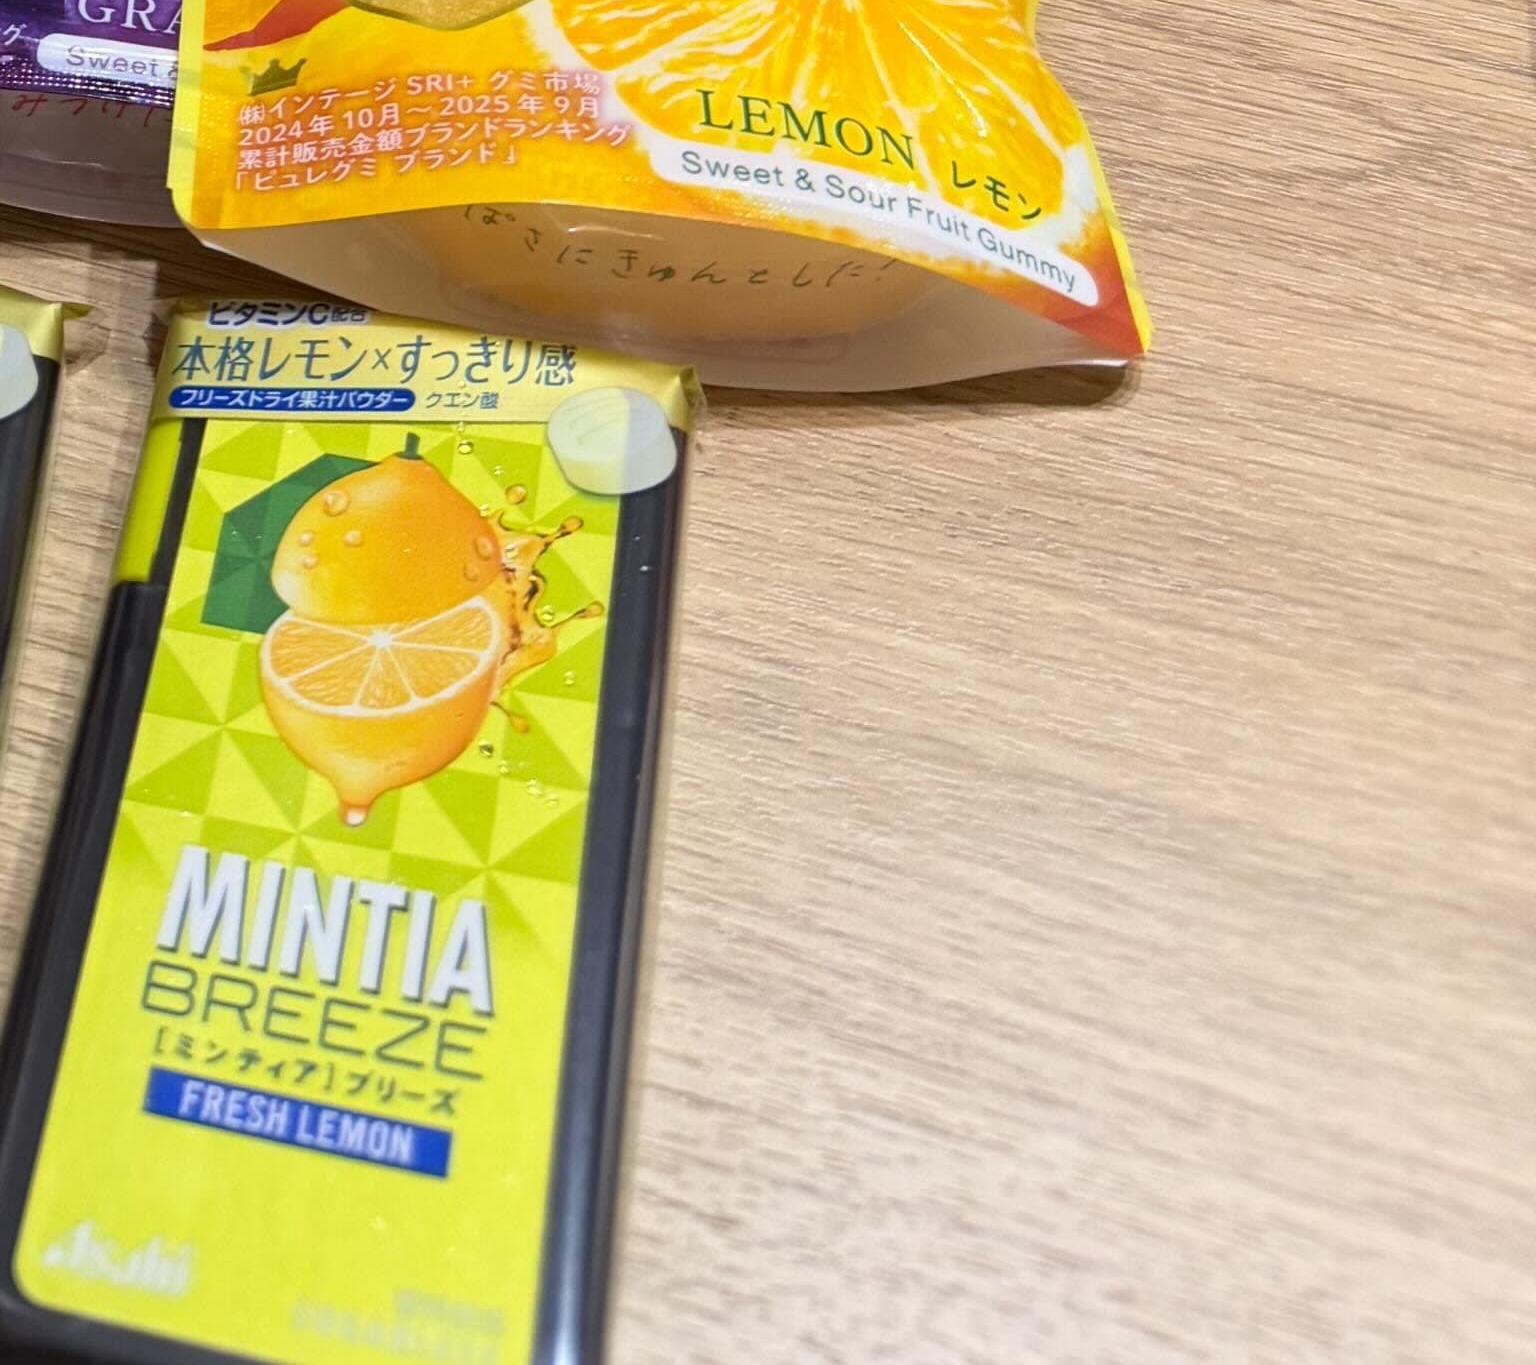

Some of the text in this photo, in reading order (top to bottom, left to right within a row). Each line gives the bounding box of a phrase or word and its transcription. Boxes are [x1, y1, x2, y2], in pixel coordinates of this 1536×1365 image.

[66, 44, 160, 78] Sweet
[407, 74, 474, 95] SRI+
[488, 70, 602, 95] グミ市場
[237, 122, 632, 170] 累計販売金額ブランドランキング
[695, 88, 1043, 222] LEMON レモン
[681, 150, 1079, 295] Sweet & Sour Fruit Gummy
[207, 301, 368, 329] ビタミンC配合
[169, 334, 578, 388] 本格レモン×すっきり感
[178, 388, 500, 411] フリーズドライ果汁パウダー クエン酸
[157, 843, 495, 1018] MINTIA
[140, 958, 489, 1084] BREEZE
[178, 1079, 416, 1166] FRESH LEMON
